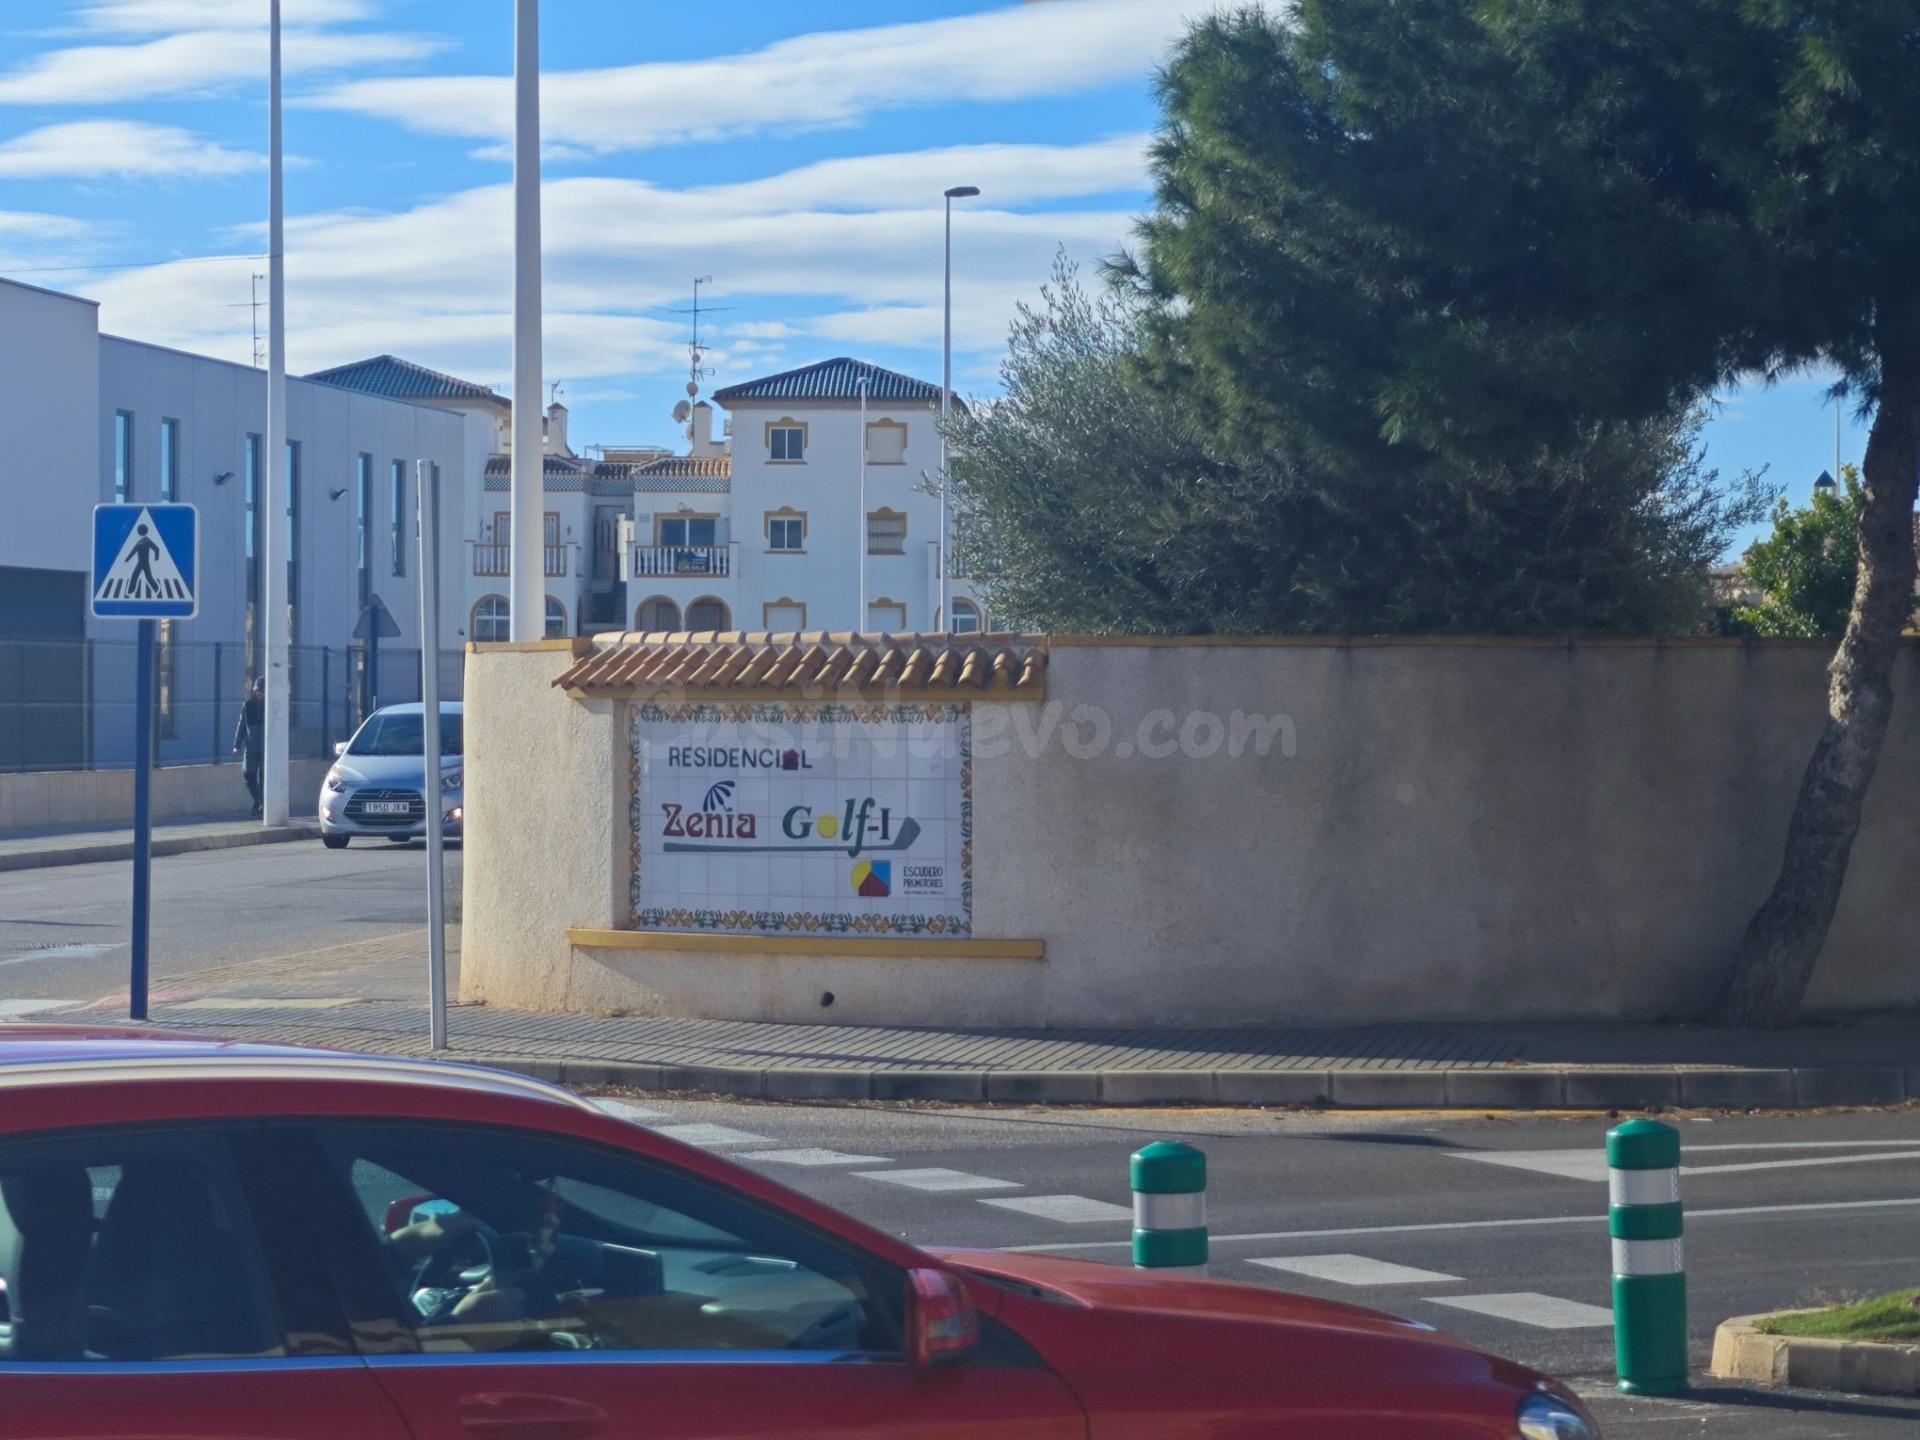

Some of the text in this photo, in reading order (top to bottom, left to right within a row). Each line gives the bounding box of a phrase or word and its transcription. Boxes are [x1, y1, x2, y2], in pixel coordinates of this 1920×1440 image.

[668, 746, 813, 771] RESIDENCIL
[661, 803, 757, 839] Zenia
[903, 865, 944, 878] ESCUDERO
[903, 878, 944, 889] PROMOTORES
